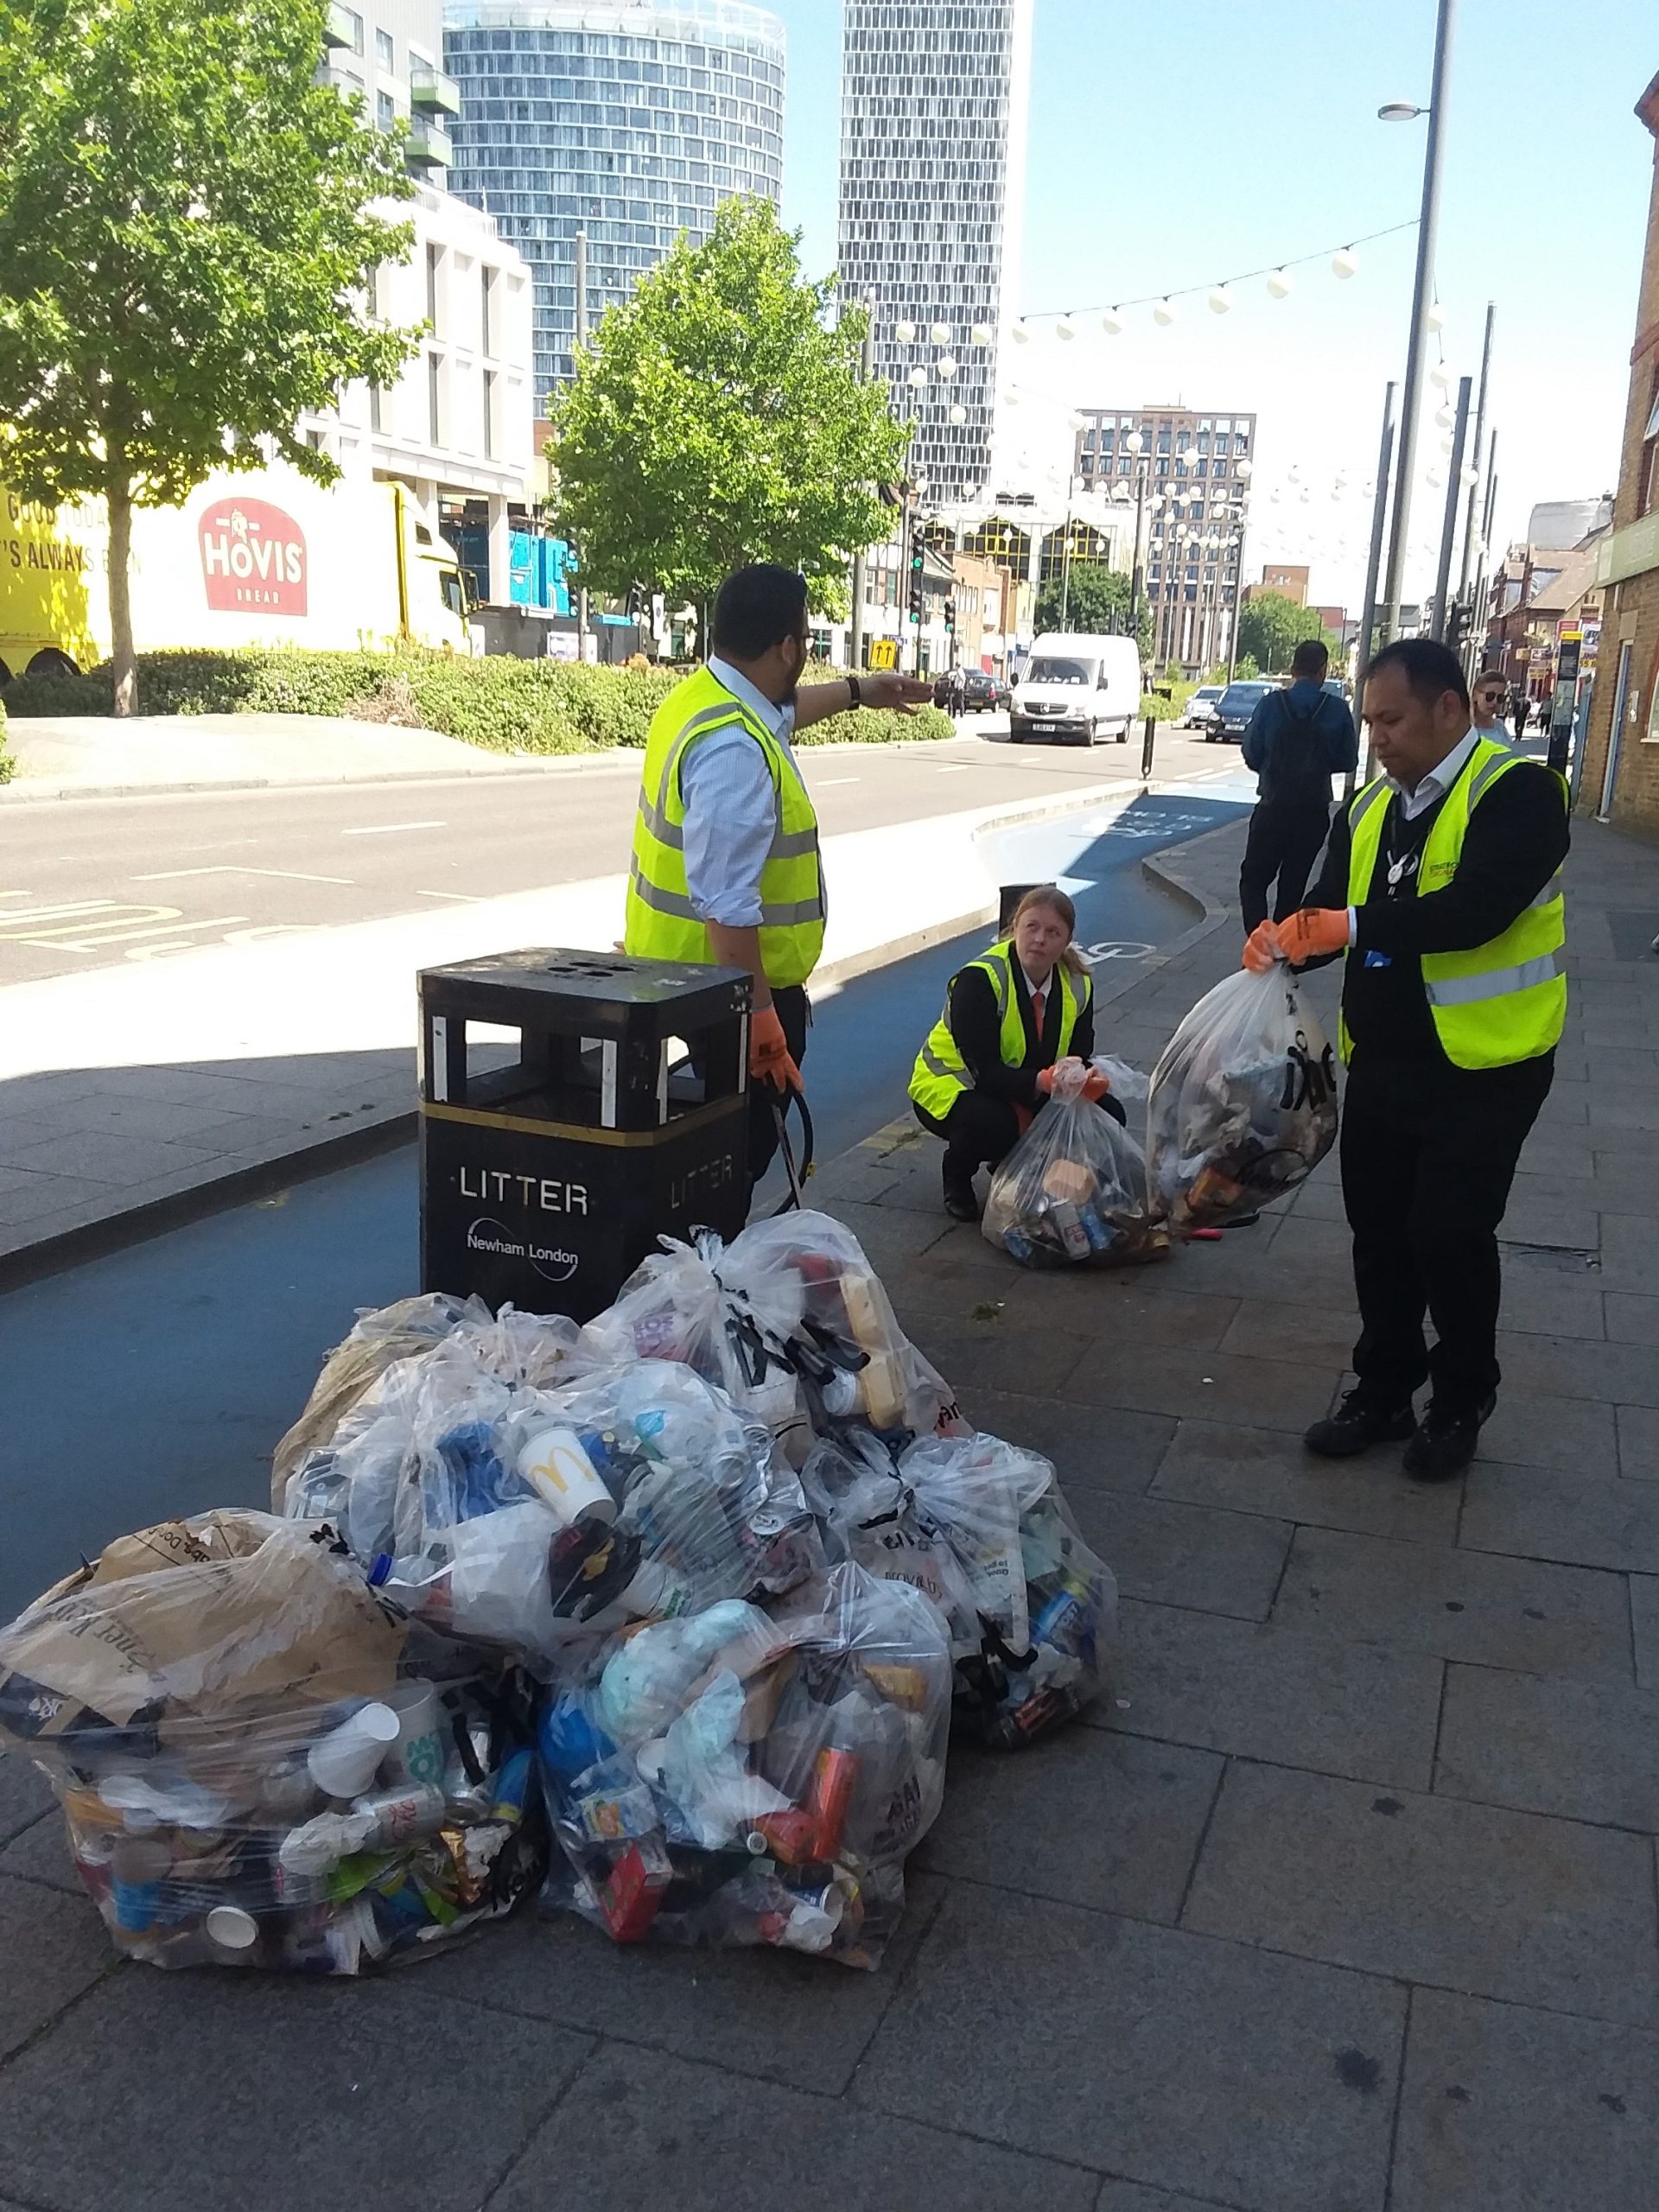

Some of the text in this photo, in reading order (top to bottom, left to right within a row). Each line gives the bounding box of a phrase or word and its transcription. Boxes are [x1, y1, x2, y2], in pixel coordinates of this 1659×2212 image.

[29, 541, 95, 572] ALWAYS
[203, 531, 303, 584] HOVIS
[236, 587, 281, 605] BREAD
[459, 1166, 589, 1217] LITTER
[671, 1154, 733, 1209] LITTER
[467, 1234, 579, 1266] Newham London
